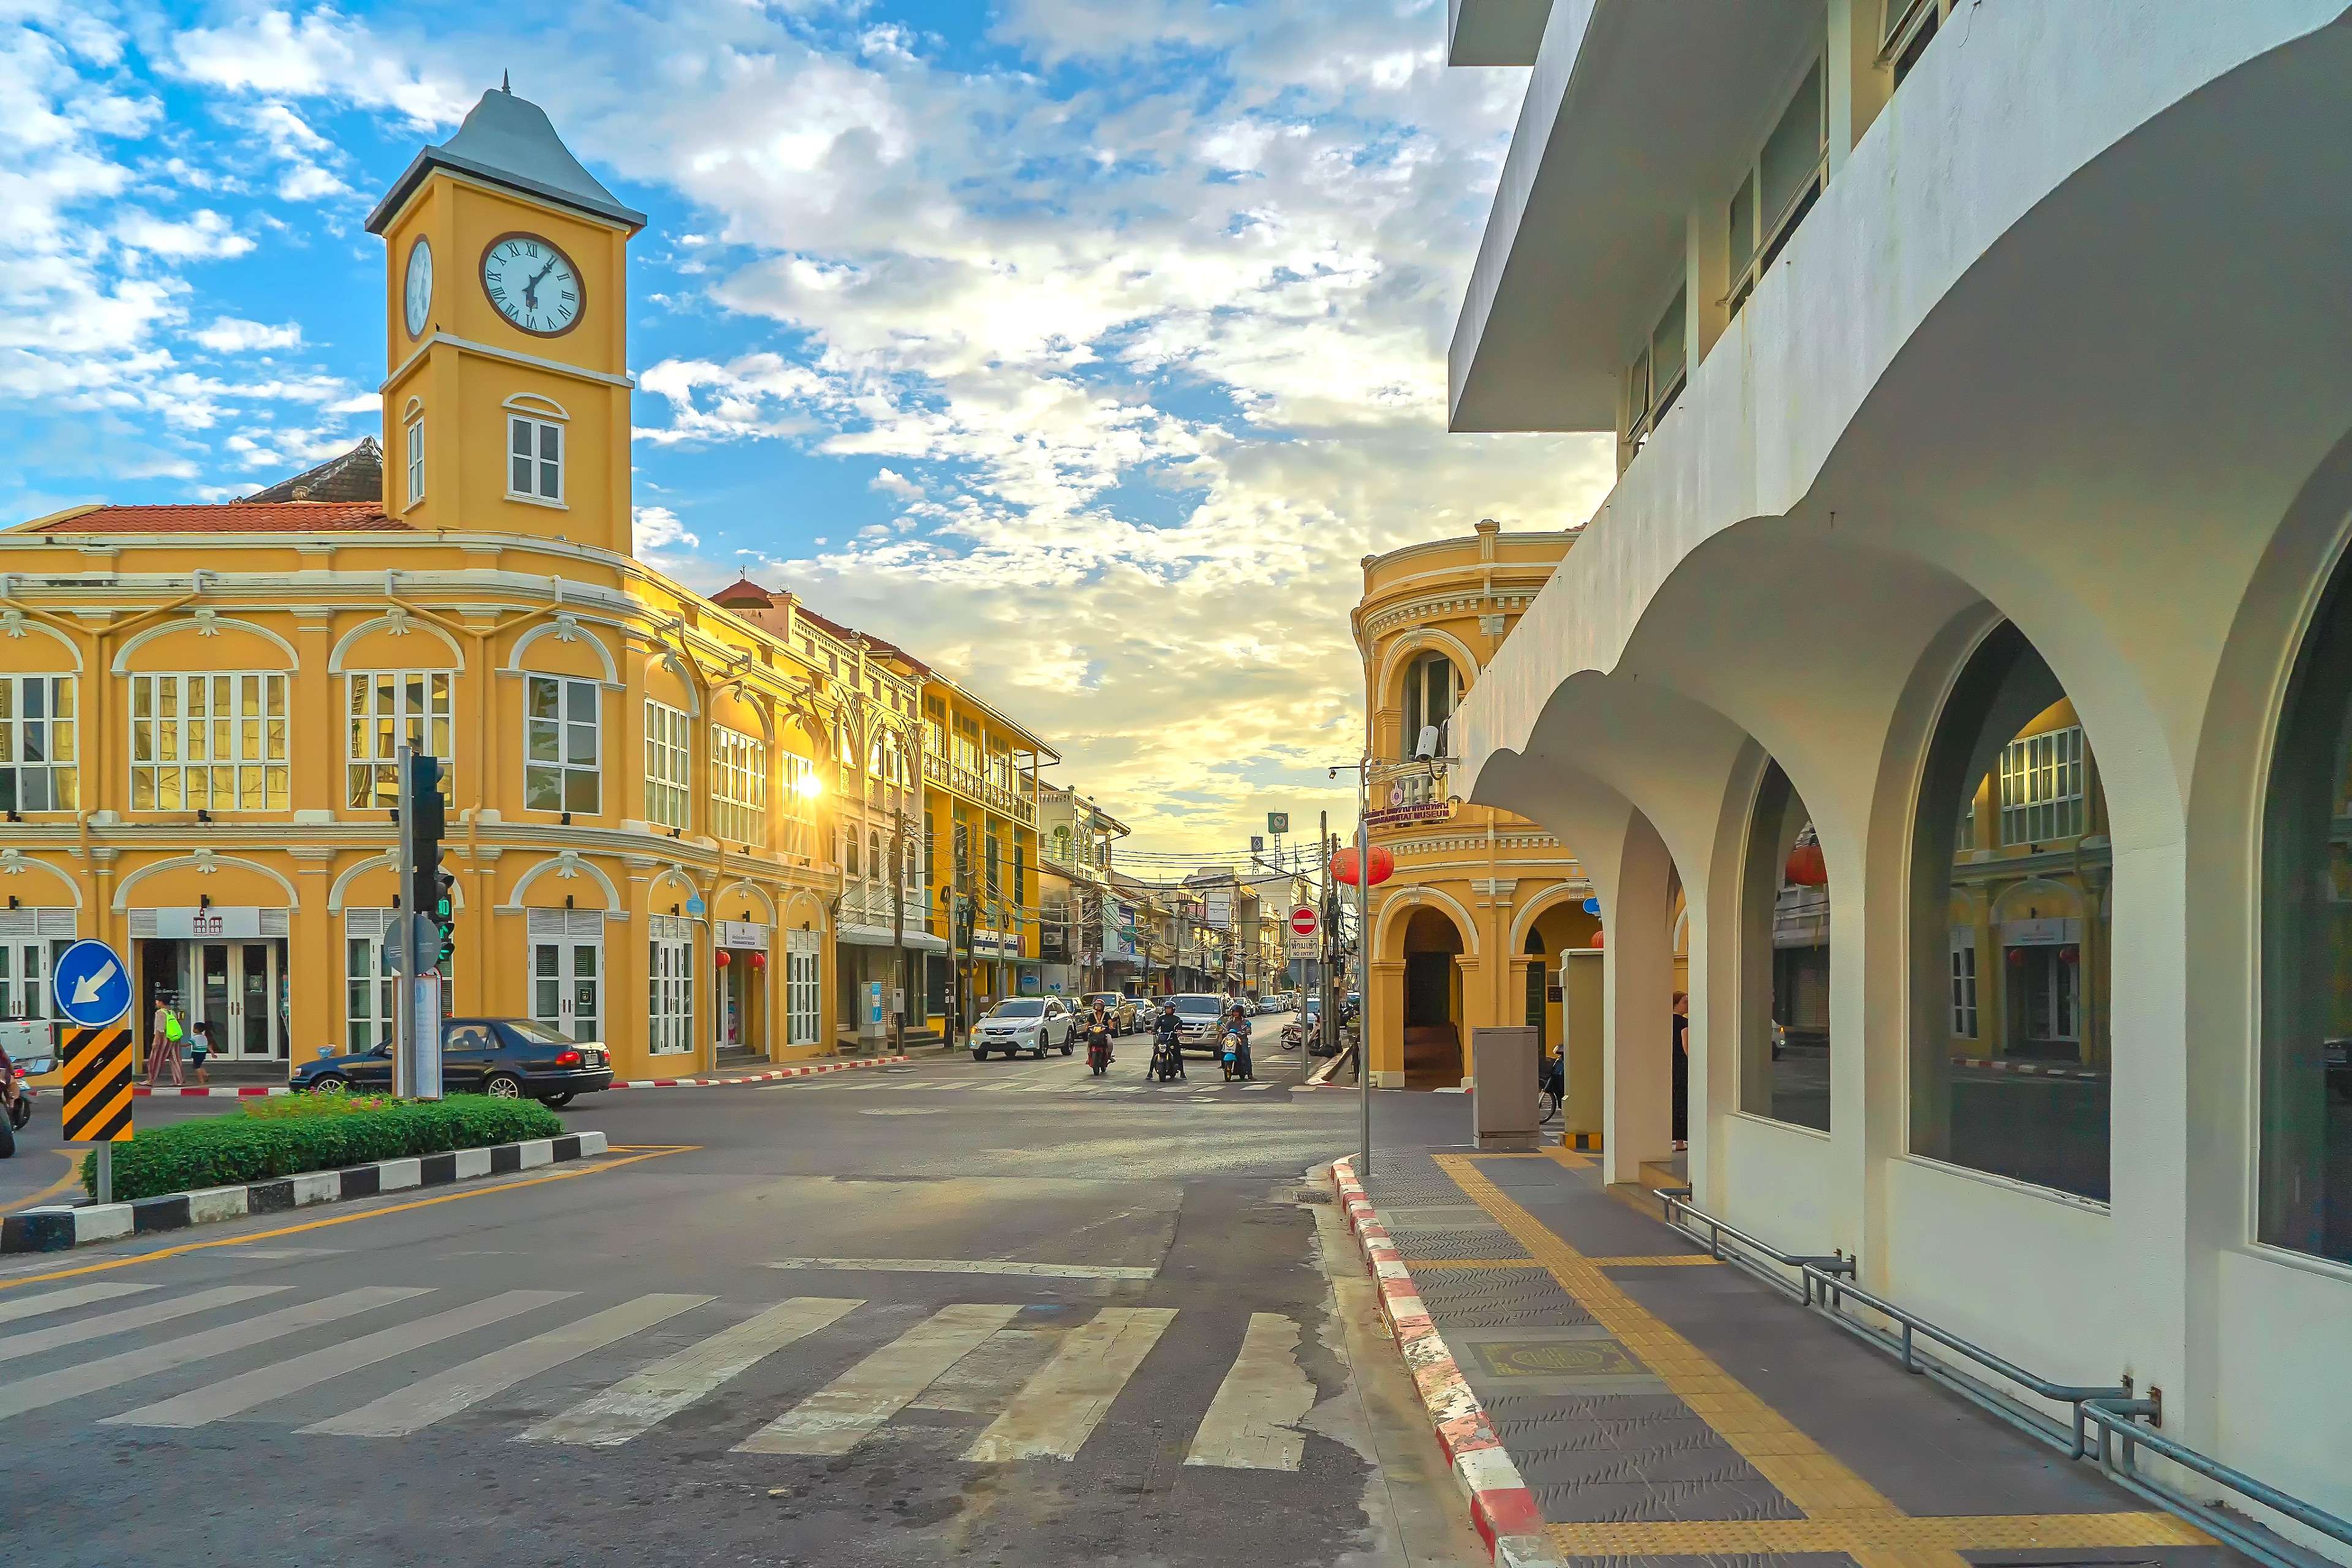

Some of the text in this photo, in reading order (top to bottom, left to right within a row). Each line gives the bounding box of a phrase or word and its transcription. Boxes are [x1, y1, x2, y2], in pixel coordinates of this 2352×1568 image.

[505, 243, 521, 257] XI
[526, 242, 538, 258] XII
[492, 252, 507, 266] X
[487, 269, 502, 283] IX
[556, 273, 570, 282] II
[491, 287, 507, 304] VIII
[561, 289, 575, 302] III
[504, 302, 519, 322] VII
[557, 304, 573, 321] IV
[526, 314, 538, 330] VI
[546, 315, 557, 330] V
[1414, 810, 1450, 819] MUSEUM
[1291, 940, 1317, 949] ห้ามเข้า
